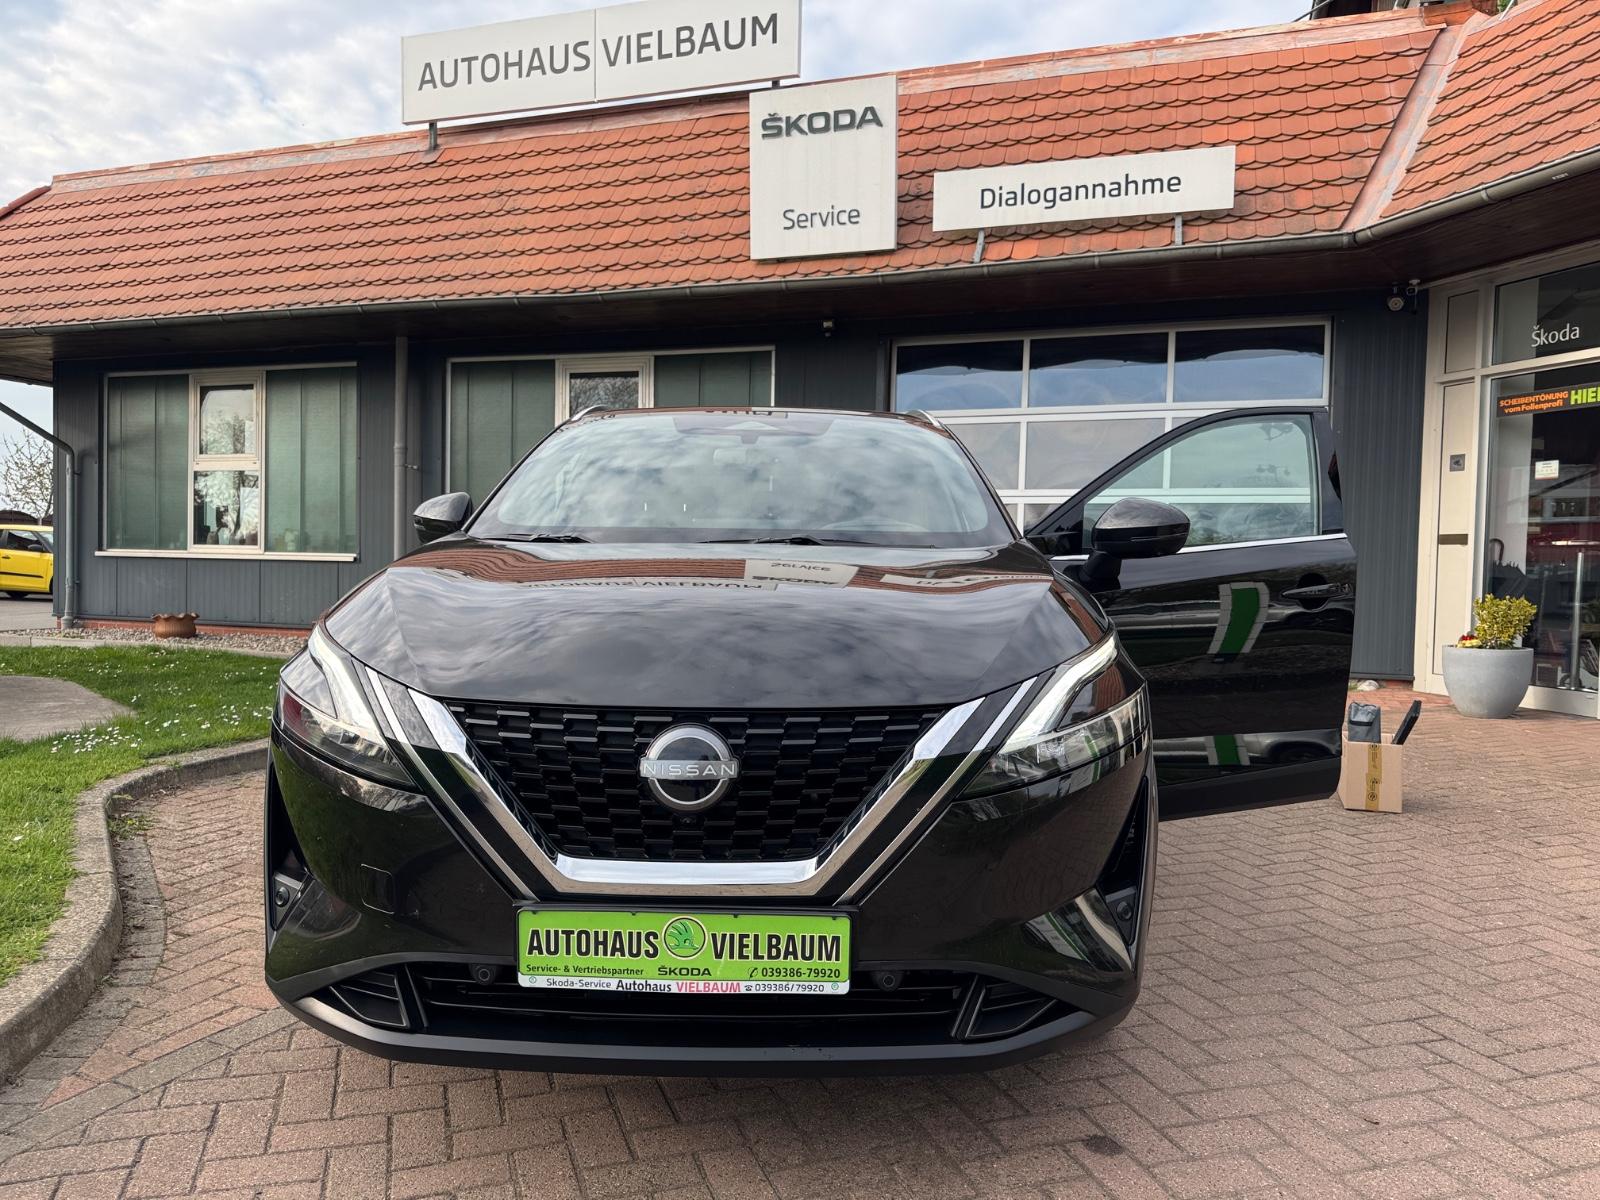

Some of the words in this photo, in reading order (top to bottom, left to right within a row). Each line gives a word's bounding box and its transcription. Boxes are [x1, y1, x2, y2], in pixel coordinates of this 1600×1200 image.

[418, 40, 591, 91] AUTOHAUS
[602, 13, 778, 67] VIELBAUM
[761, 105, 883, 139] ŠKODA
[980, 174, 1182, 209] Dialogannahme
[783, 205, 861, 230] Service
[1531, 323, 1580, 347] Škoda
[1521, 400, 1564, 411] Folienprofi
[643, 764, 736, 776] NISSAN
[528, 930, 659, 959] AUTOHAUS
[711, 932, 841, 961] VIELBAUM
[526, 964, 562, 973] Service-
[563, 965, 570, 973] &
[572, 965, 645, 976] Vertriebspartner
[657, 965, 712, 977] ŠKODA
[761, 967, 841, 979] 039386-79920
[546, 978, 612, 989] Skoda-Service
[615, 980, 672, 993] Autohaus
[676, 981, 741, 993] VIELBAUM
[754, 983, 825, 993] 039386/79920
